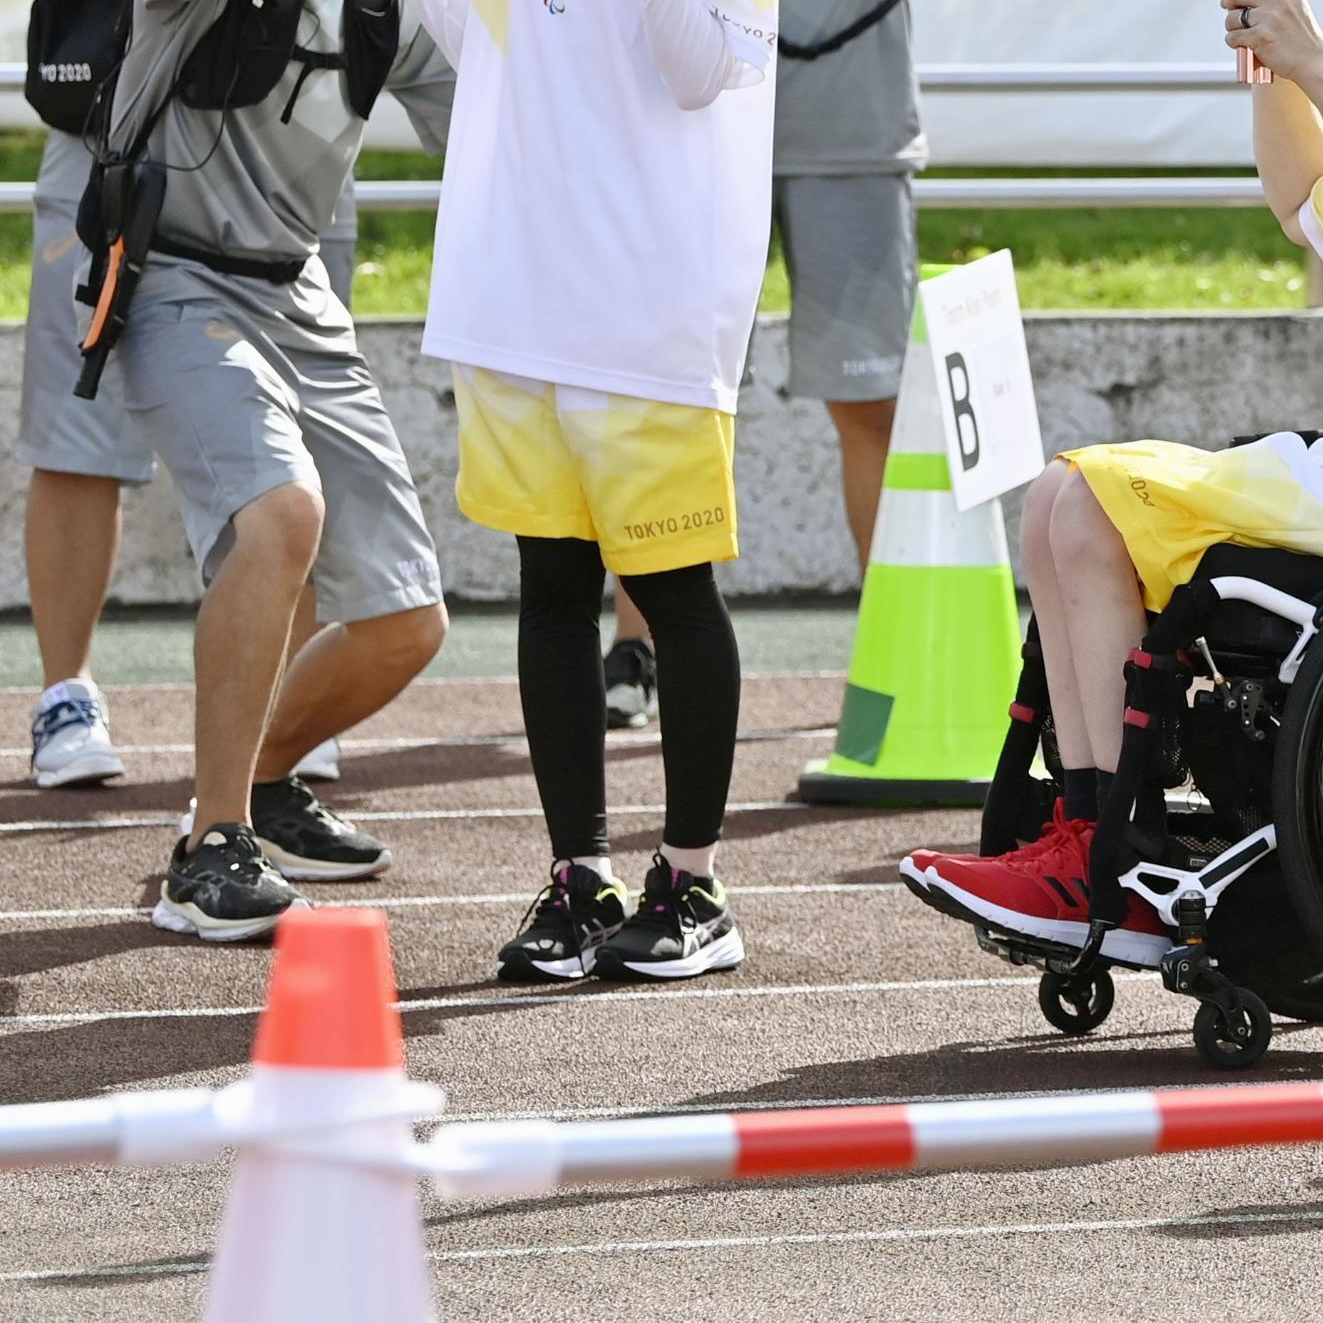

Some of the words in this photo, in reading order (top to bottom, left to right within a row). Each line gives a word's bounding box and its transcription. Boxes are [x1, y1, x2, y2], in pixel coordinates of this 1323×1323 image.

[58, 62, 92, 82] 2020
[944, 351, 980, 471] B
[623, 517, 679, 541] TOKYO
[680, 506, 725, 531] 2020
